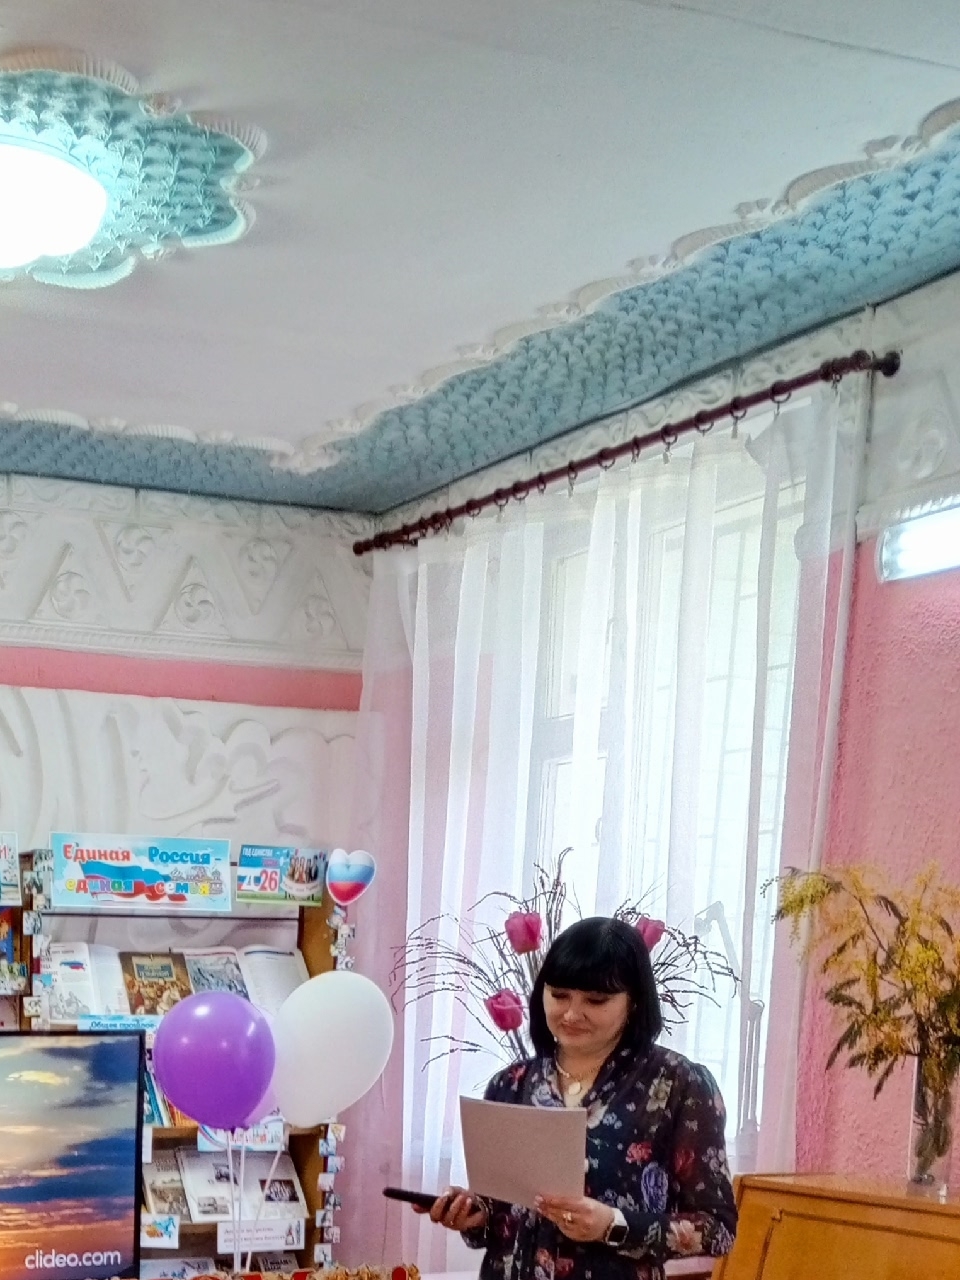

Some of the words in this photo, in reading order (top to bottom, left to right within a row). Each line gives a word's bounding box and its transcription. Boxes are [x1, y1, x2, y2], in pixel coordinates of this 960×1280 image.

[63, 844, 131, 862] Единая
[148, 846, 210, 865] Россия
[66, 879, 134, 894] единая
[154, 881, 211, 896] семья
[24, 1249, 121, 1270] clideo.com
